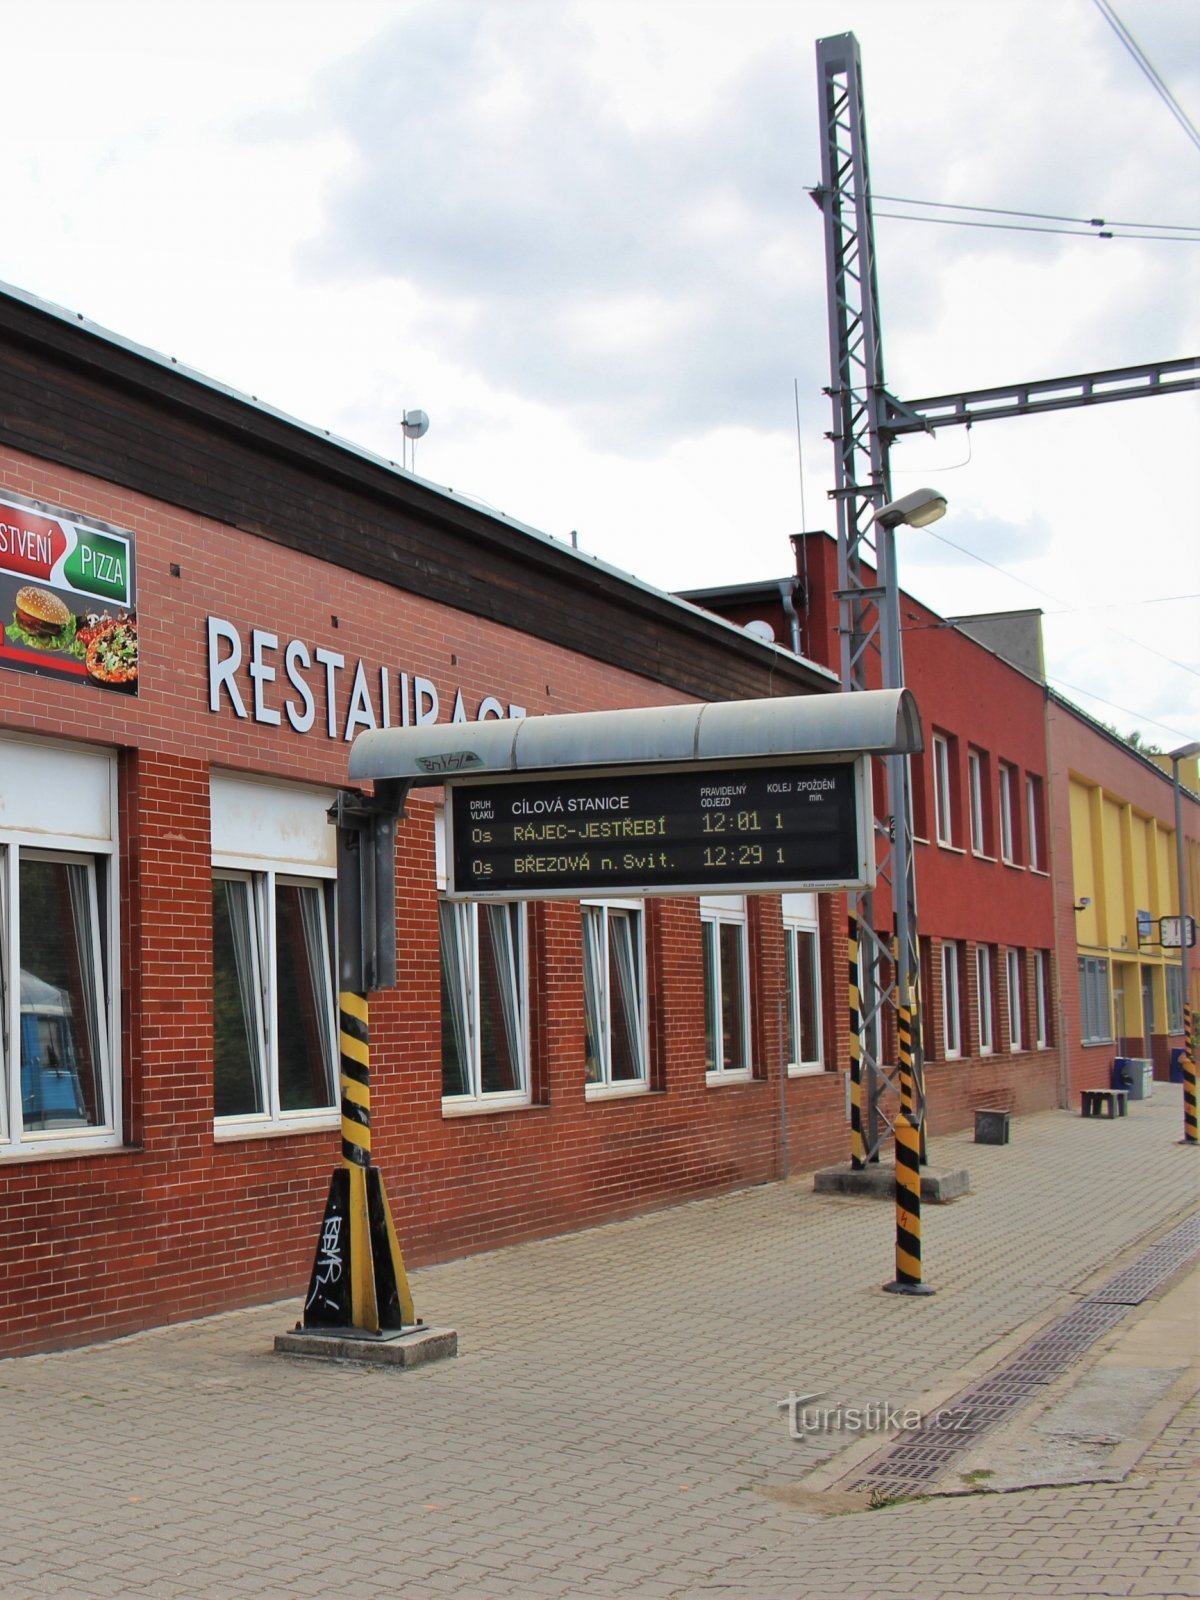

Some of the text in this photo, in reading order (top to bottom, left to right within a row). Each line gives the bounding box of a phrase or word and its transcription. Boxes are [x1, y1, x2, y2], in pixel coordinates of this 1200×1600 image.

[81, 544, 124, 587] PIZZA
[206, 614, 527, 742] RESTAUR
[700, 782, 747, 797] PRAVIDELNÝ
[766, 777, 836, 793] KOLEJ ZPOŽDĚNÍ
[469, 800, 491, 810] DRUH
[511, 796, 630, 815] CÍLOVÁ STANICE
[700, 797, 731, 808] ODJEZD
[808, 793, 824, 802] min.
[470, 810, 495, 820] VLAKU
[471, 810, 784, 843] Os RÁJEC-JESTŘEBÍ 12:01 1
[472, 860, 494, 875] Os
[514, 852, 591, 874] BŘEZOVÁ
[703, 844, 763, 867] 12:29
[776, 847, 785, 864] 1
